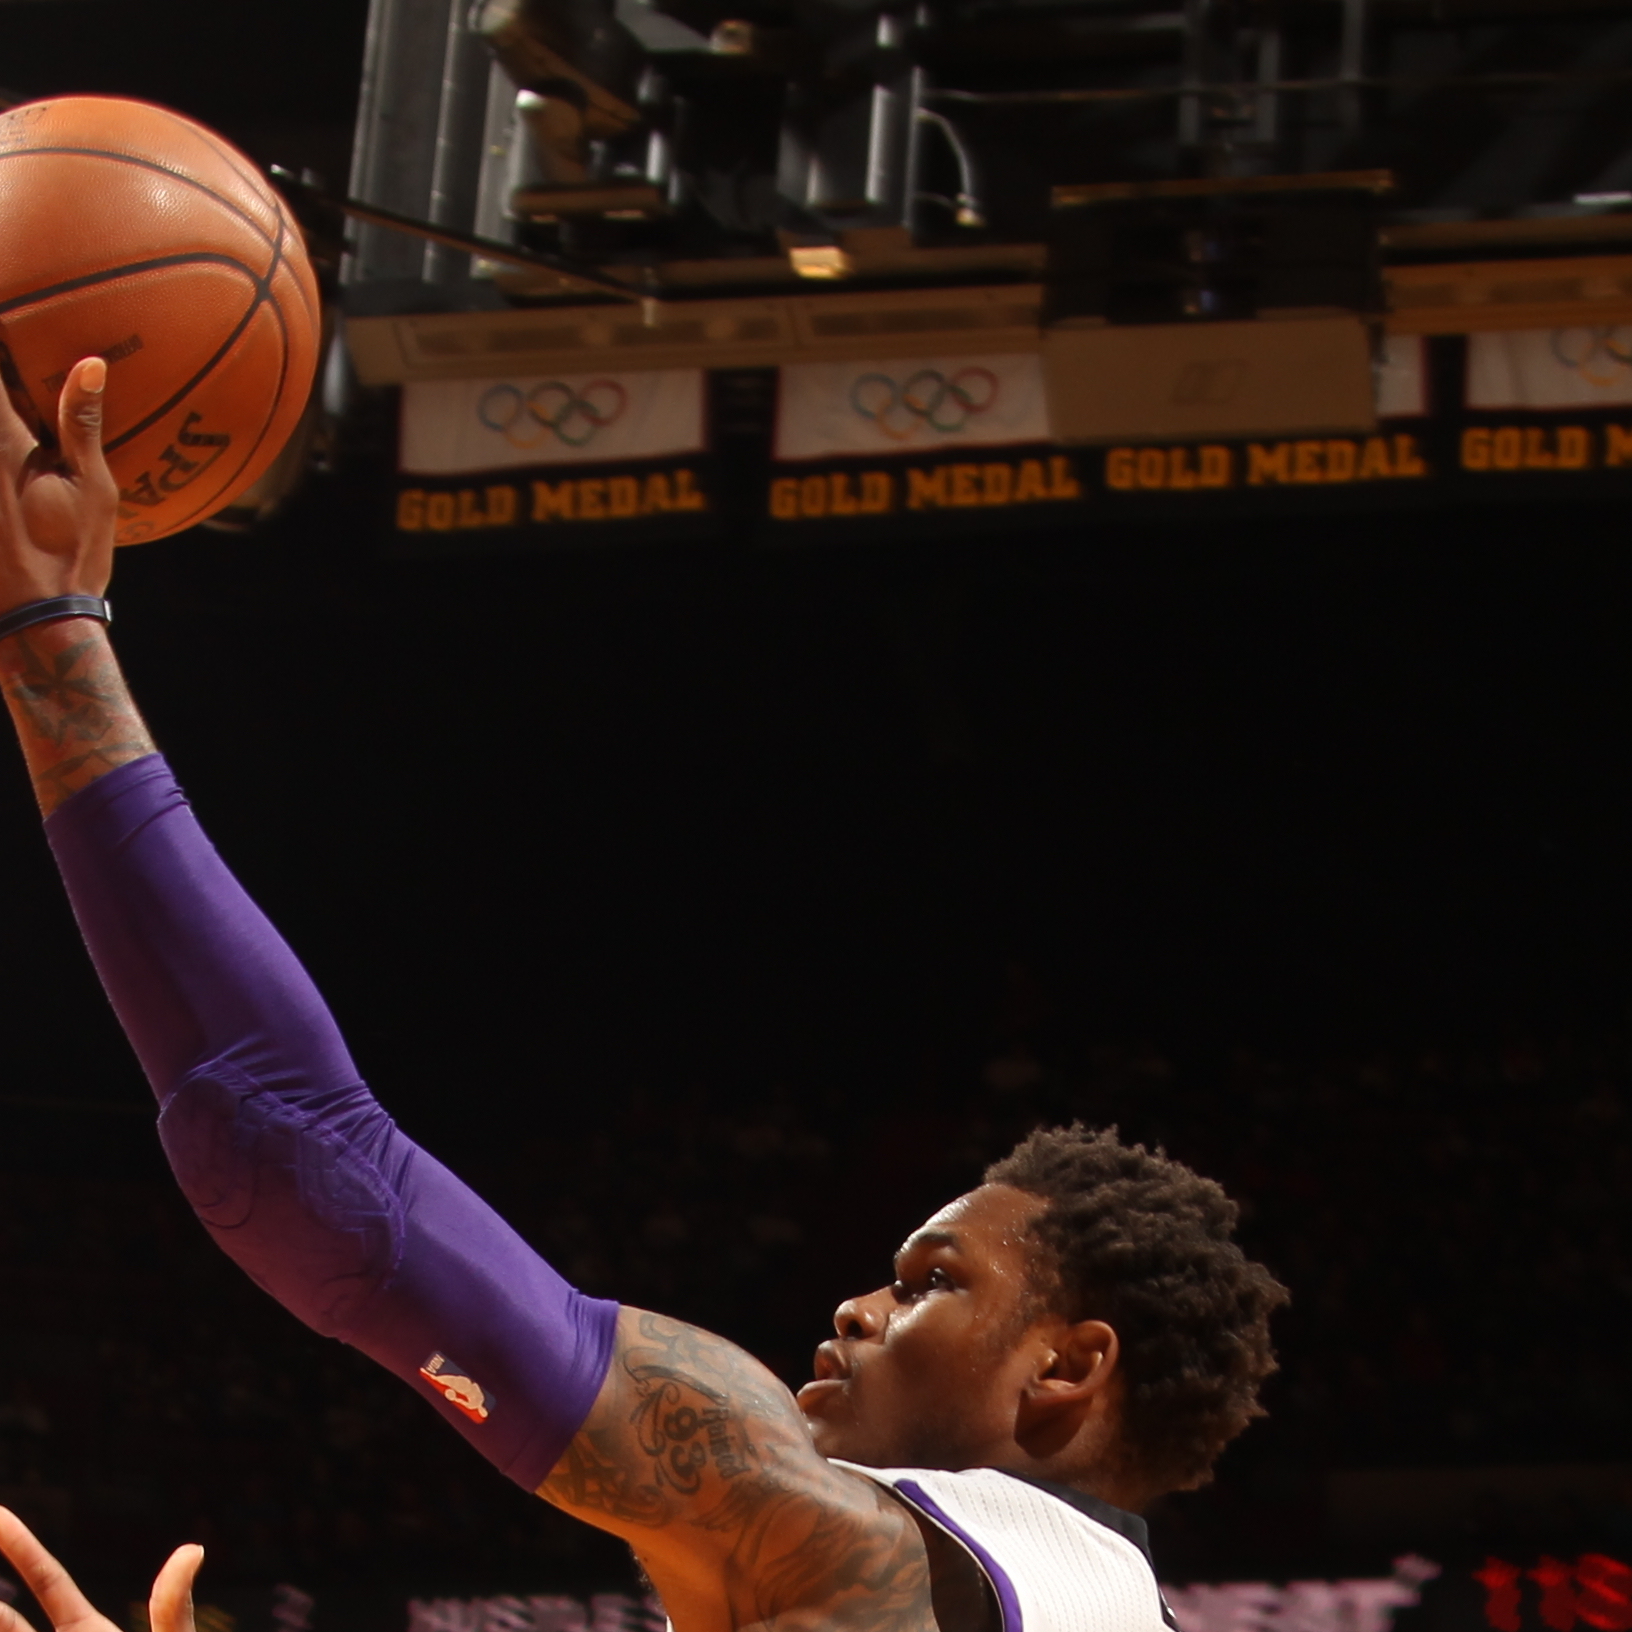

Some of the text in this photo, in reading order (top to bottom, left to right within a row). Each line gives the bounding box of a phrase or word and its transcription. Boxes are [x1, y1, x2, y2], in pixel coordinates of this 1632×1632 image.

[1105, 433, 1429, 491] GOLD MEDAL
[1460, 424, 1591, 472] GOLD
[395, 467, 706, 533] GOLD MEDAL
[769, 455, 1080, 521] GOLD MEDAL
